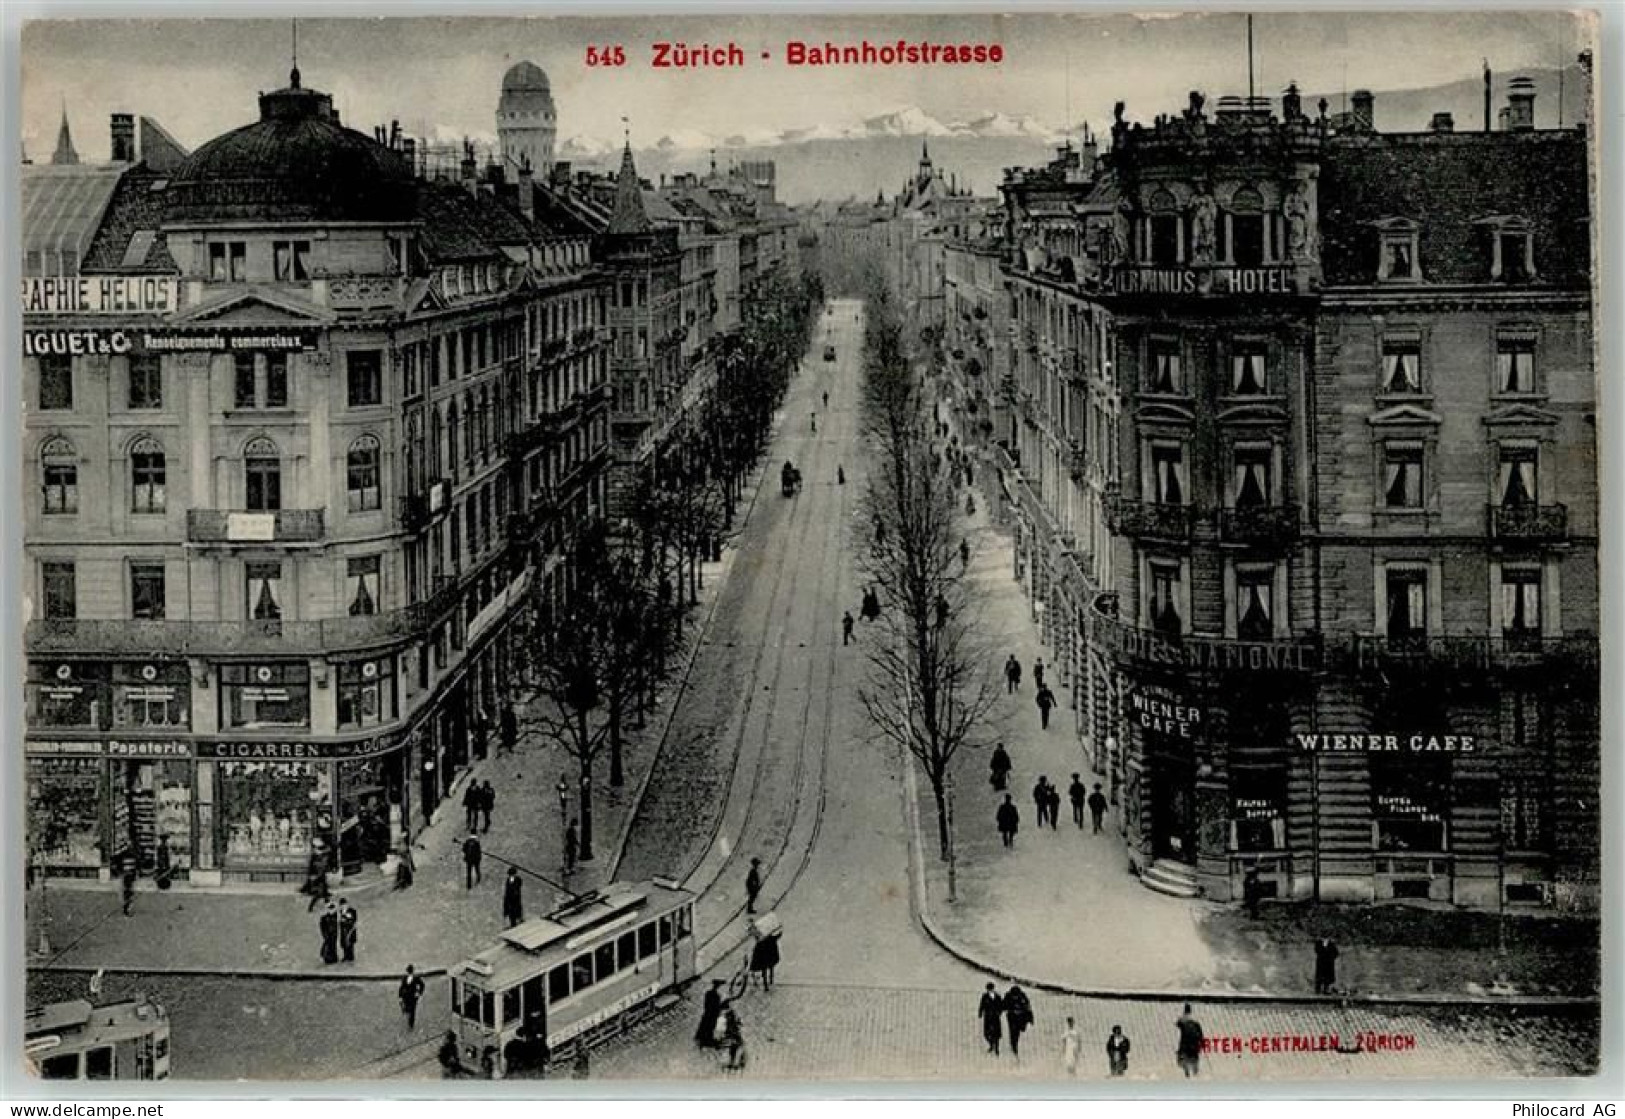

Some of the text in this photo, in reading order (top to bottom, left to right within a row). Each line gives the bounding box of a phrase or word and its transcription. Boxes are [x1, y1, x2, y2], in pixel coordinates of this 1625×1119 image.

[1229, 269, 1291, 293] HOTEL
[101, 279, 168, 310] HELIOS
[1189, 643, 1315, 670] NATIONAL
[1132, 692, 1200, 723] WIENER
[1141, 712, 1191, 738] CAFE
[216, 743, 319, 756] CIGARREN
[1297, 734, 1475, 751] WIENER CAFE
